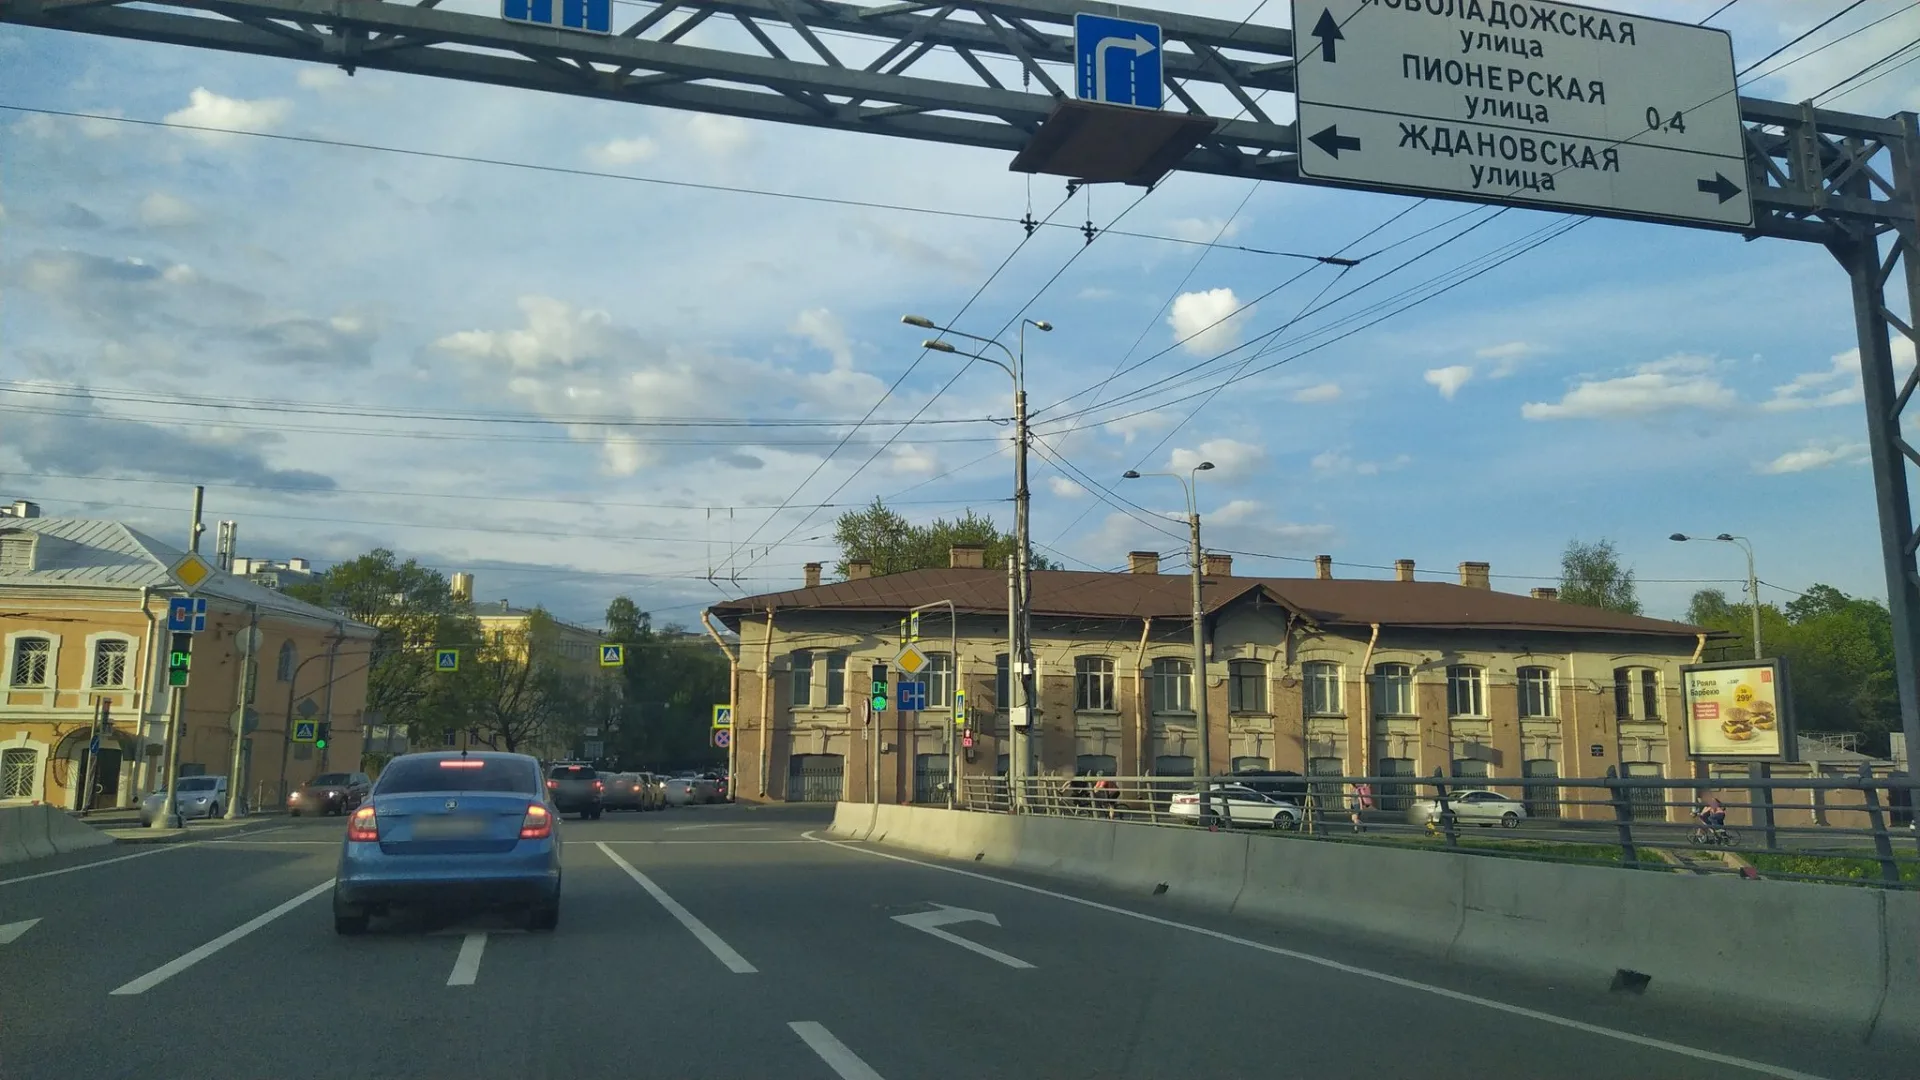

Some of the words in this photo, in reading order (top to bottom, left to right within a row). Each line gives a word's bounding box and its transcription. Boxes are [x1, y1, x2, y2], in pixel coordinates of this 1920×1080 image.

[1361, 0, 1637, 46] ВОЛАДОЖСКАЯ
[1461, 30, 1544, 58] улица
[1403, 54, 1606, 105] ПИОНЕРСКАЯ
[1466, 94, 1550, 124] улица
[1646, 107, 1686, 134] 0,4
[1398, 122, 1620, 173] ЖДАНОВСКАЯ
[1470, 163, 1556, 193] улица
